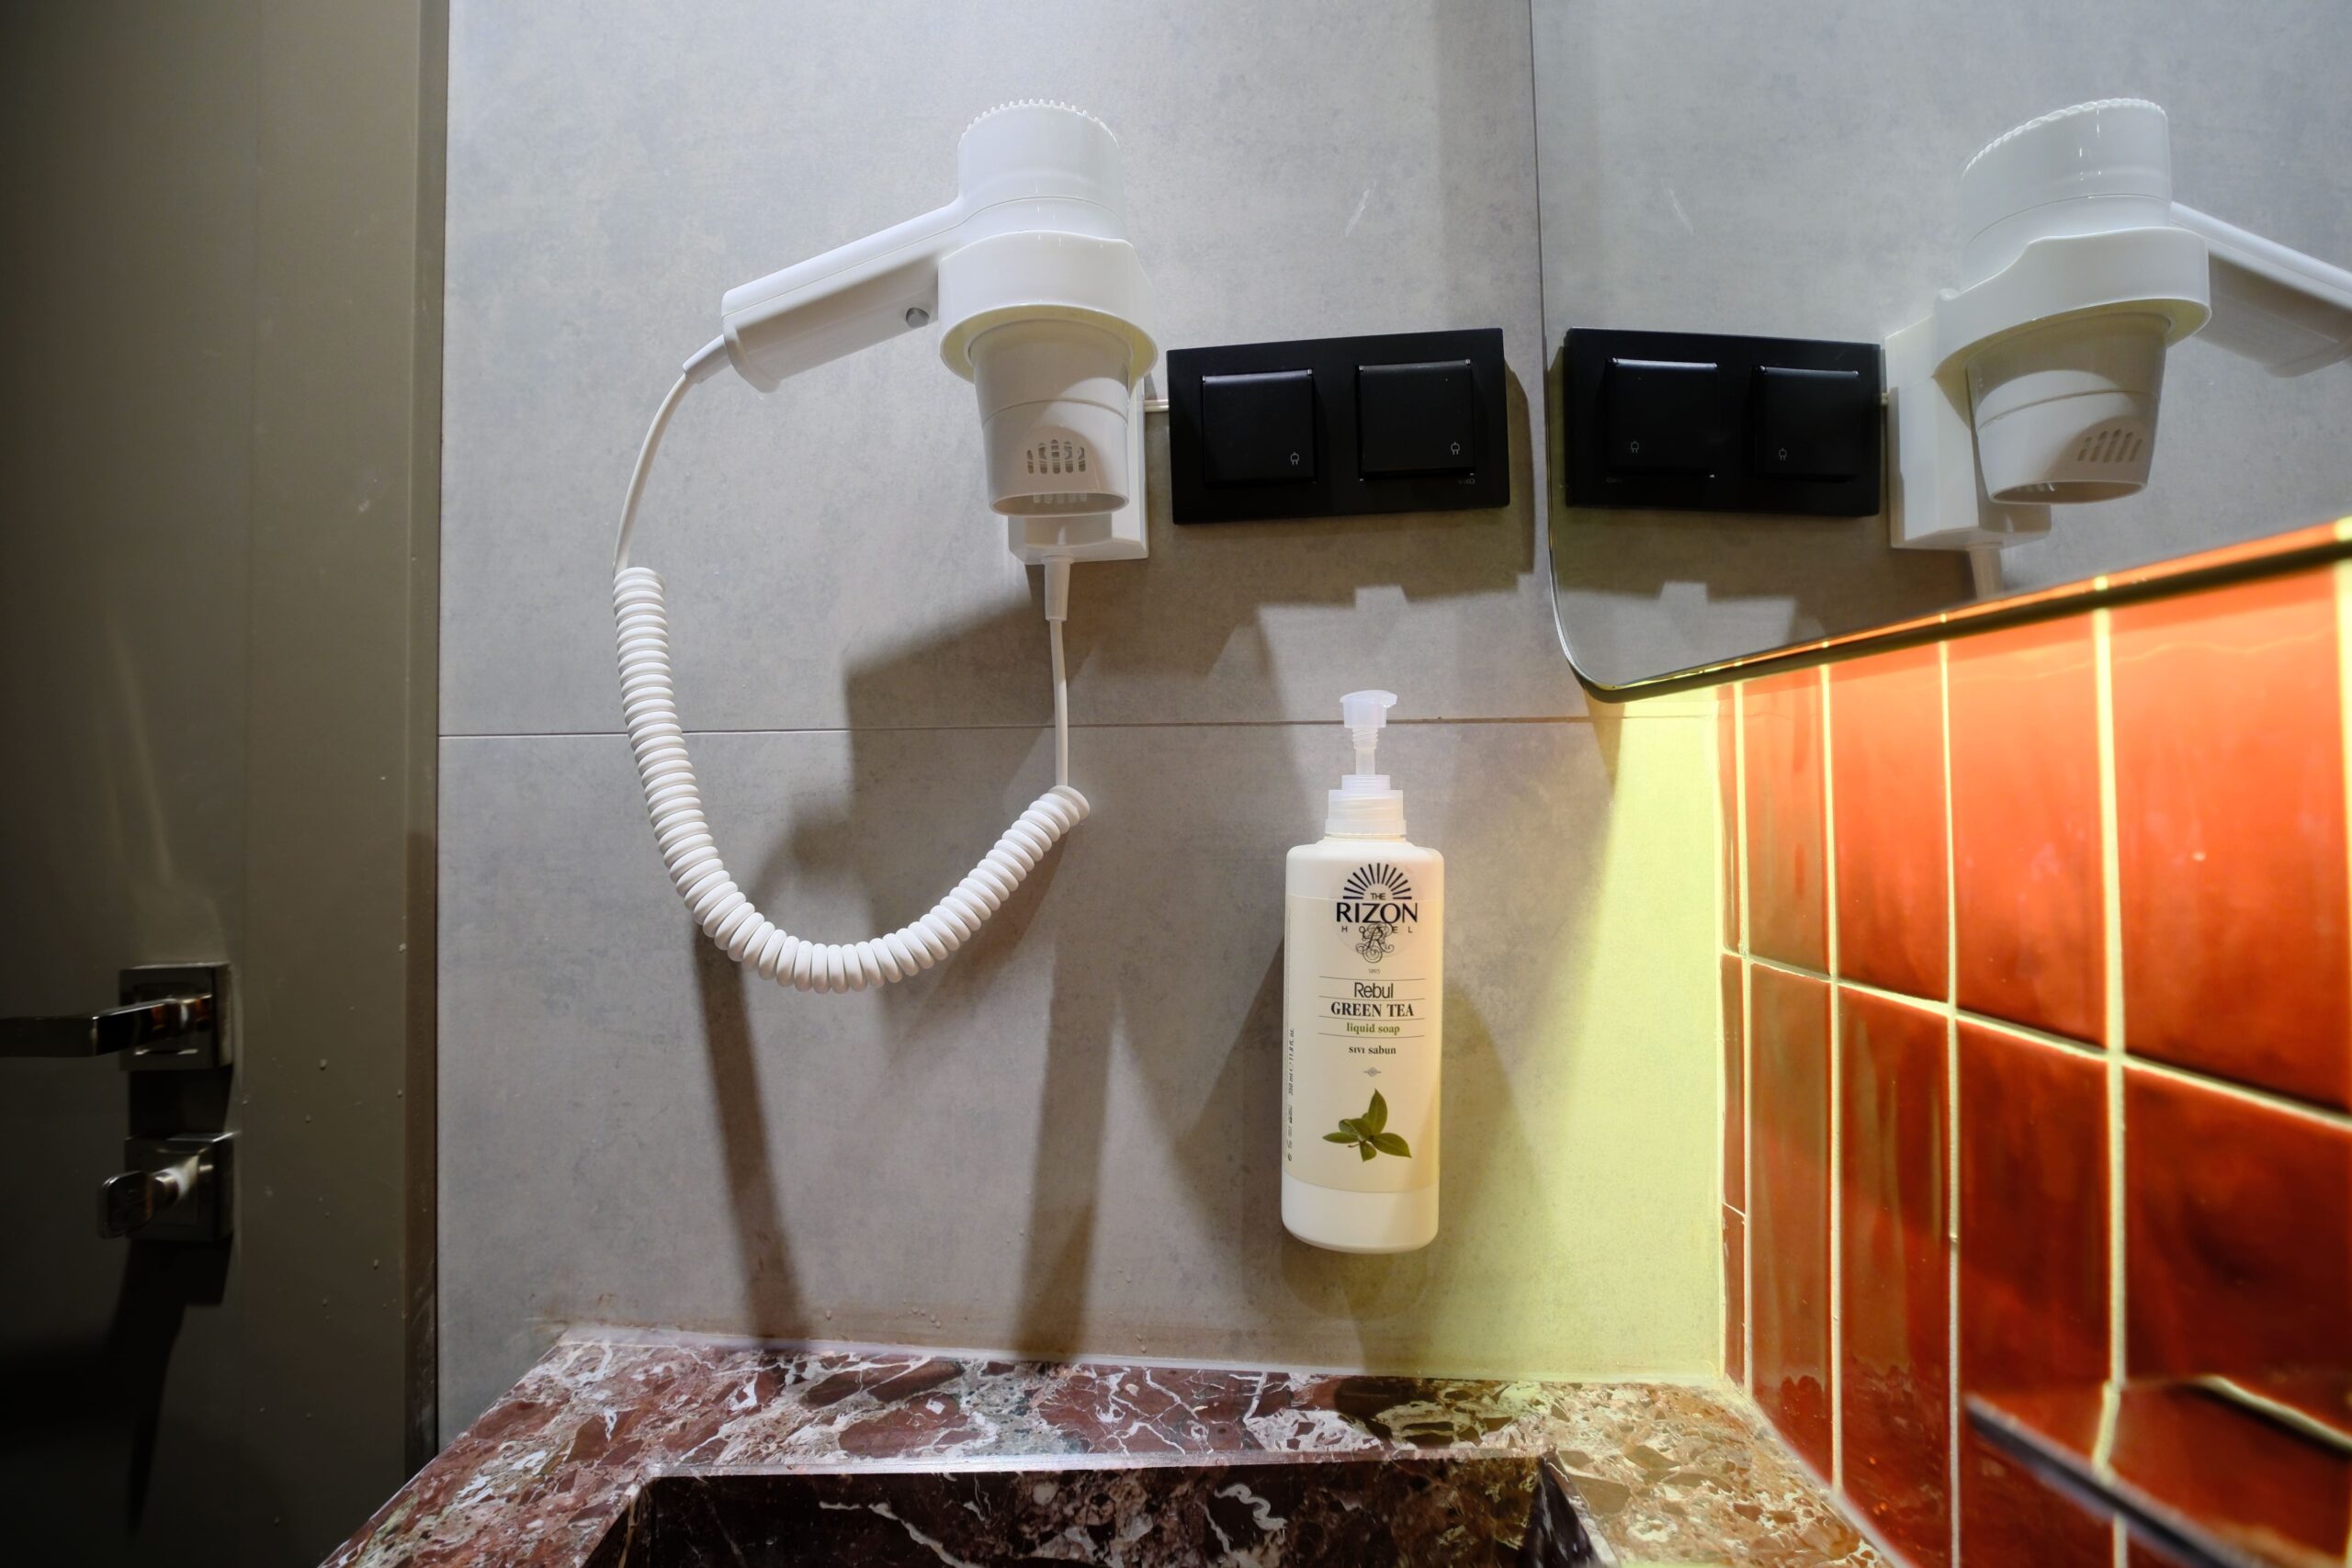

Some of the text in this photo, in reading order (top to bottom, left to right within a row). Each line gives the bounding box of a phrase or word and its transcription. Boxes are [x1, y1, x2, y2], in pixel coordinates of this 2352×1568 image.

[1336, 902, 1418, 923] RIZON
[1354, 982, 1394, 998] Rebul
[1330, 1001, 1414, 1017] GREEN TEA
[1346, 1022, 1400, 1035] liquid soap
[1368, 1045, 1396, 1055] sabun
